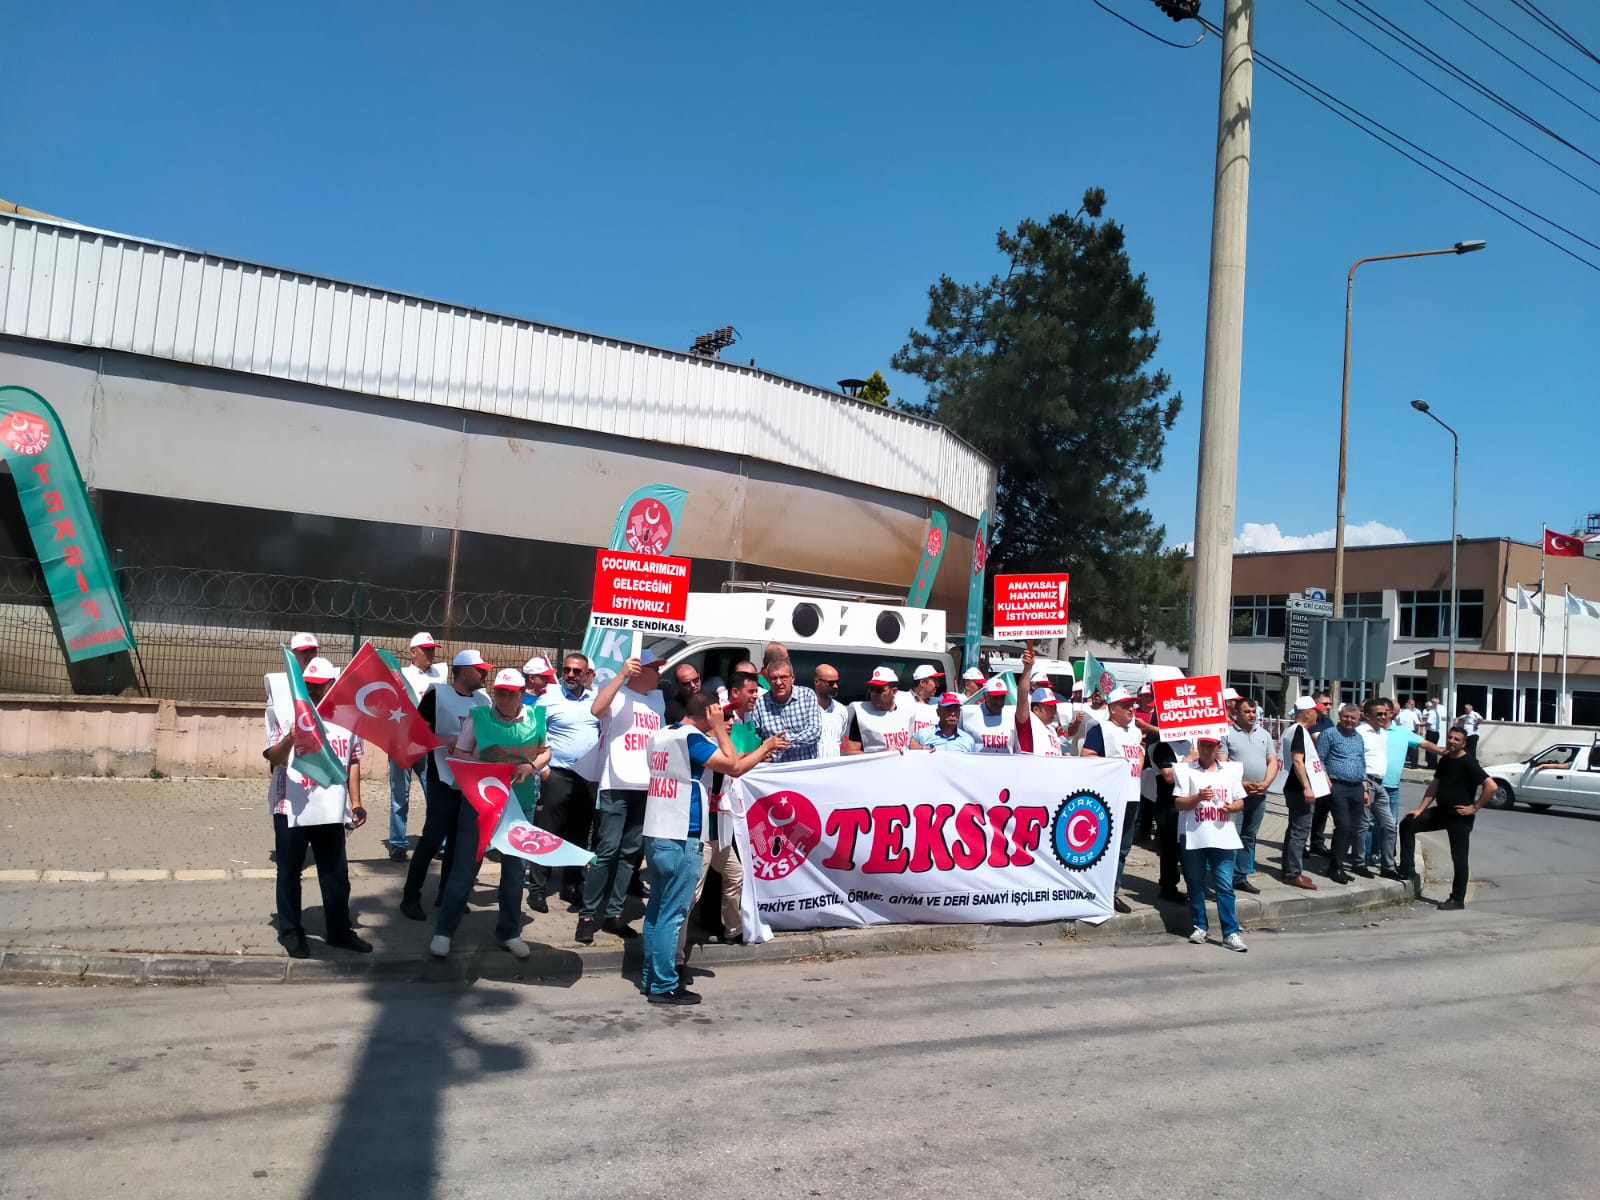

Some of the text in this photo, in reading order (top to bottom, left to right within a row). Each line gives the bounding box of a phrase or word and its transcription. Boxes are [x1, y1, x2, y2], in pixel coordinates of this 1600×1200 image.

[601, 557, 686, 577] ÇOCUKLARIMIZIN
[613, 577, 672, 594] GELECEĞİNİ
[1008, 581, 1058, 590] ANAYASAL
[1009, 591, 1058, 600] HAKKIMIZ
[612, 595, 664, 613] İSTİYORUZ
[997, 601, 1057, 611] KULLANMAK
[593, 616, 629, 628] TEKSİF
[1006, 611, 1057, 621] İSTİYORUZ
[998, 628, 1023, 637] TEKSİF
[1175, 683, 1197, 697] BİZ
[1163, 696, 1213, 710] BİRLİKTE
[633, 712, 659, 731] TEKSİF
[1160, 707, 1219, 722] GÜÇLÜYÜZ
[981, 732, 1009, 748] TEKSİF
[1163, 729, 1187, 738] TEKSİF
[822, 788, 1049, 874] TEKSİF
[924, 897, 940, 906] VE
[943, 892, 970, 907] DERİ
[972, 889, 1009, 906] SANAYİ
[1012, 888, 1050, 906] İŞÇİLERİ
